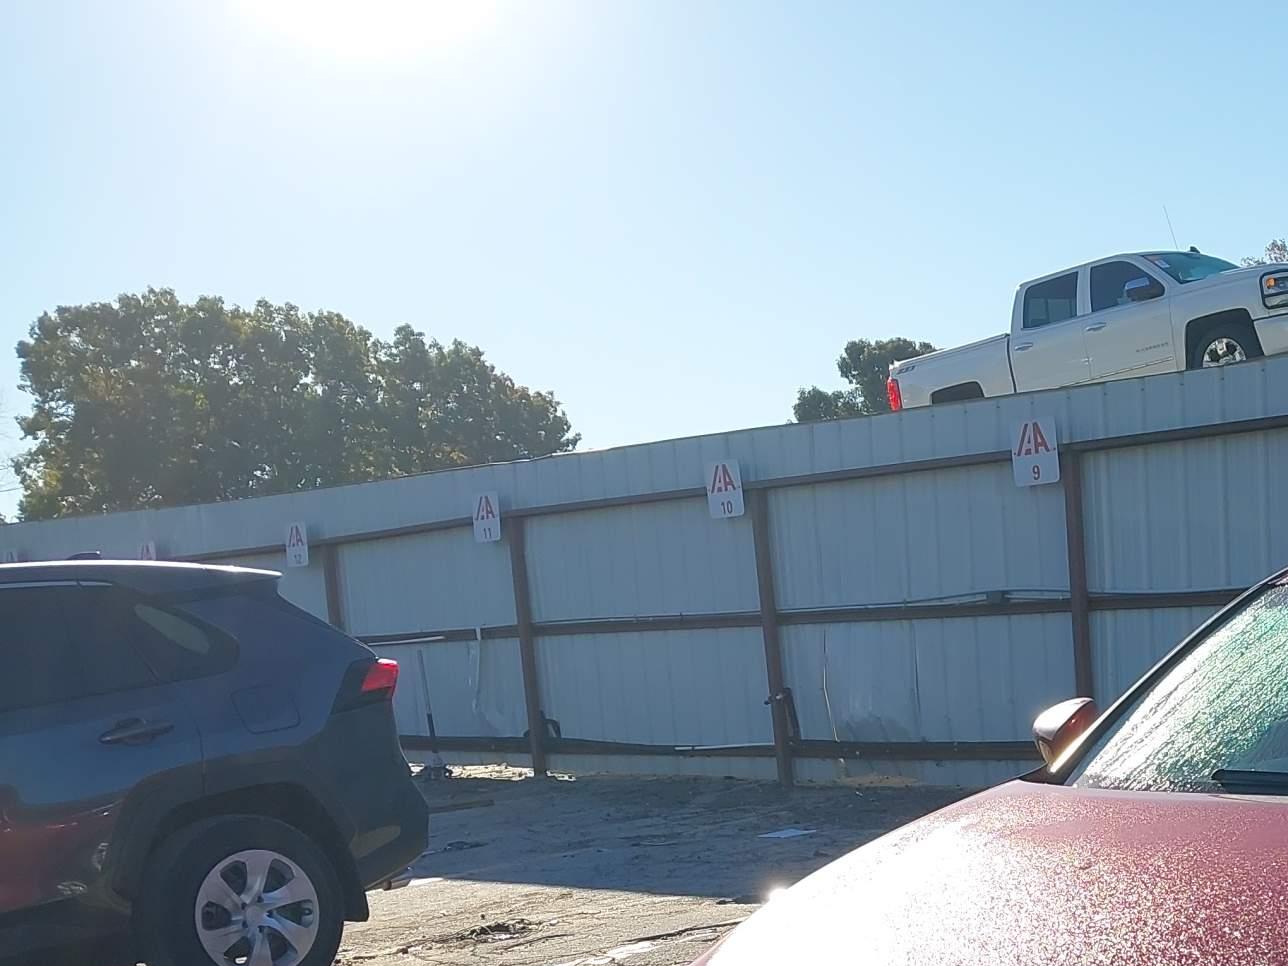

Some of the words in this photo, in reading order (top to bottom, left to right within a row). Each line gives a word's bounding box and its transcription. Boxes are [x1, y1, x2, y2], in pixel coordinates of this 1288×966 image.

[1032, 464, 1040, 480] 9
[721, 500, 733, 515] 10
[483, 527, 492, 539] 11
